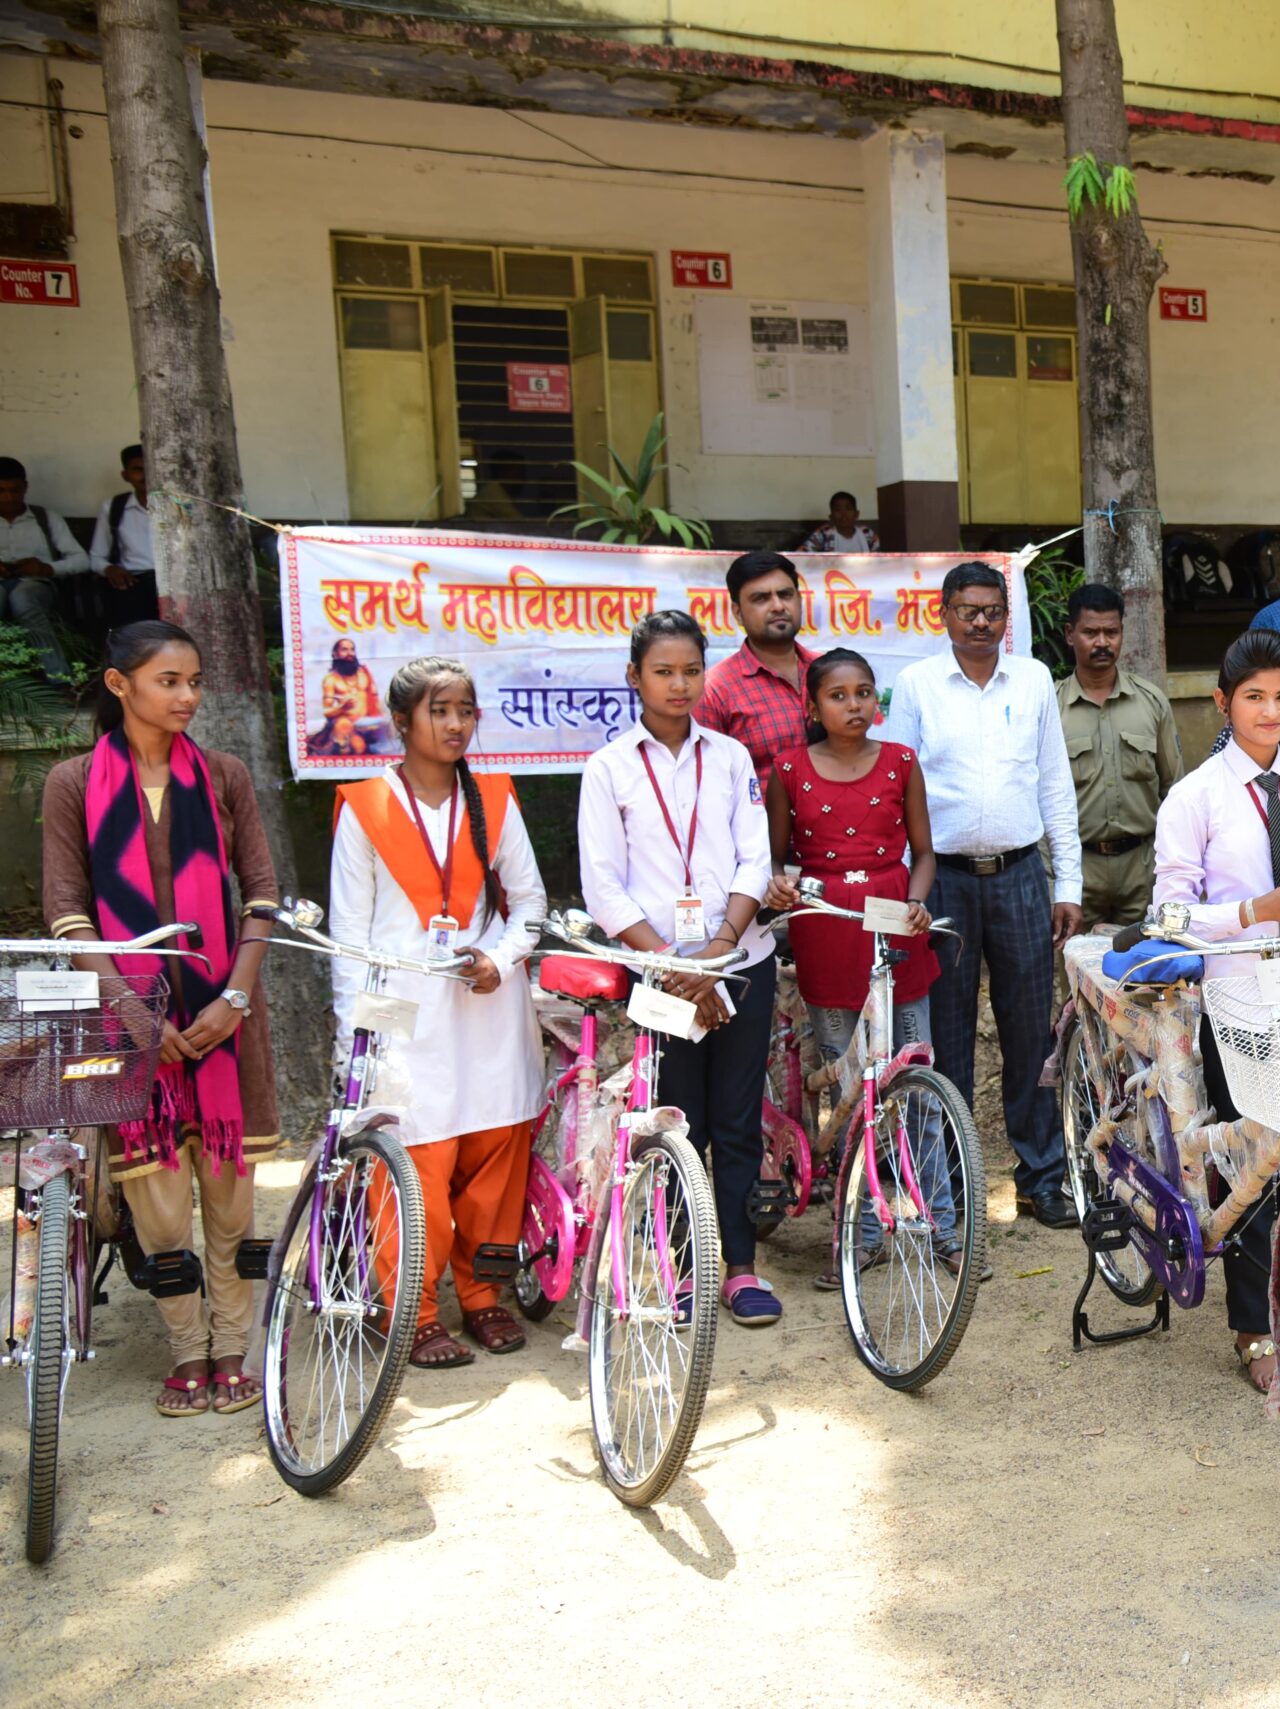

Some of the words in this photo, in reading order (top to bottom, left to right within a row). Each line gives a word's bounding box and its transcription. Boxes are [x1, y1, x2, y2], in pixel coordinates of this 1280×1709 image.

[1, 265, 43, 283] Counter
[712, 261, 722, 280] 6
[15, 282, 34, 299] No.
[51, 273, 63, 295] 7
[1191, 297, 1199, 314] 5
[535, 379, 544, 391] 6
[320, 561, 431, 634] समर्थ
[438, 564, 658, 645] महाविद्यालय
[824, 568, 883, 637] जि.
[65, 1062, 124, 1077] BRIJ
